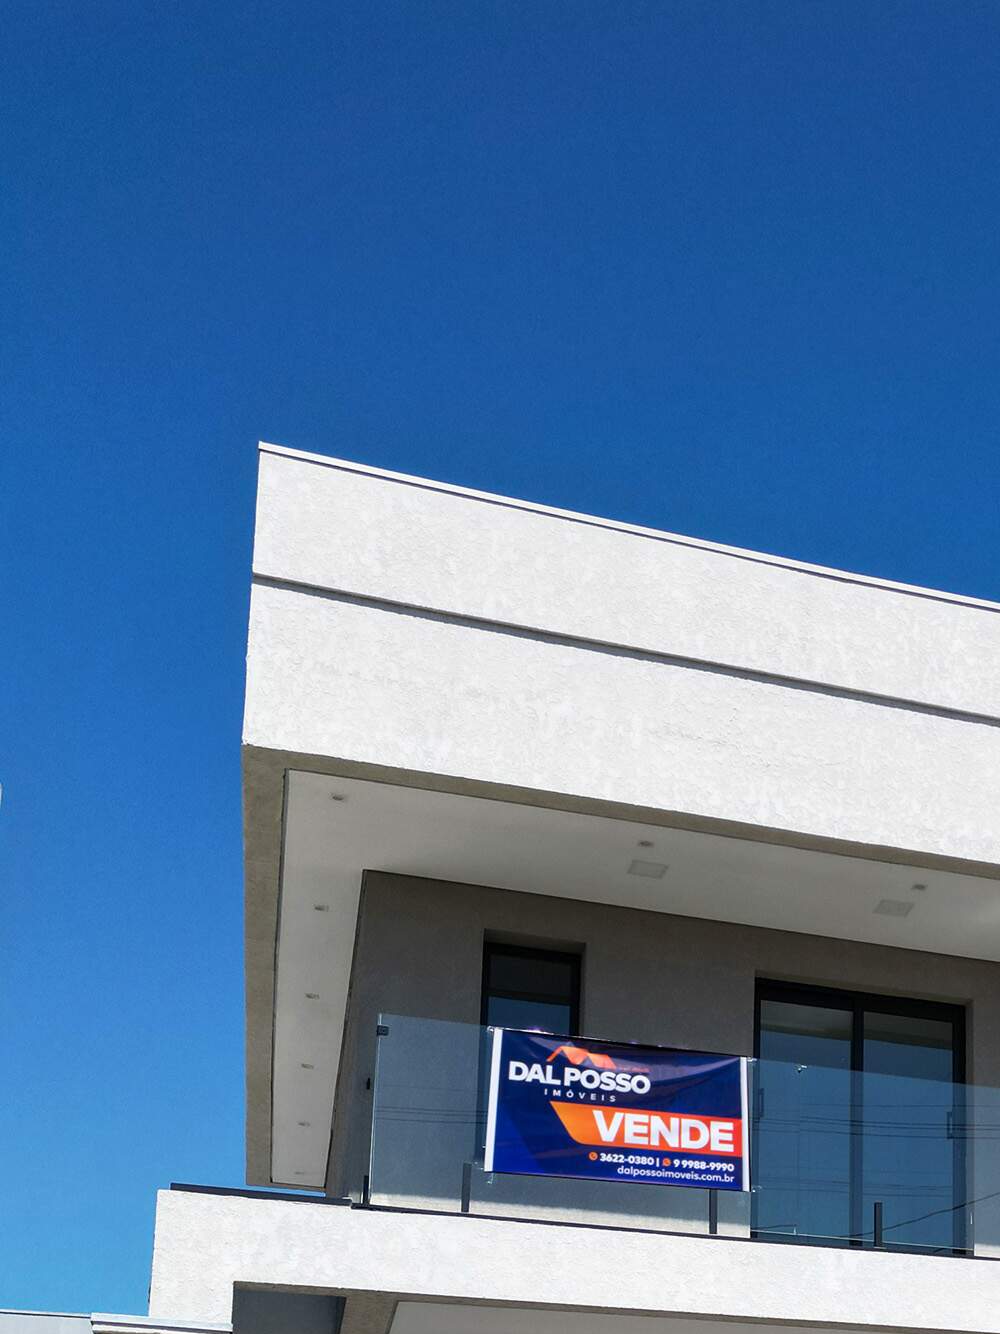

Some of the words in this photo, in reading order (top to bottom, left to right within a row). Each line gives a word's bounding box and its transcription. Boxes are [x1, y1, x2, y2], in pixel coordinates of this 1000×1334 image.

[508, 1060, 561, 1086] DAL
[563, 1067, 651, 1095] POSSO
[543, 1088, 617, 1103] IMÓVEIS
[592, 1109, 735, 1153] VENDE
[599, 1153, 655, 1165] 3622-0380
[682, 1160, 735, 1172] 9988-9990
[617, 1165, 735, 1183] dalpossoimoveis.com.br
